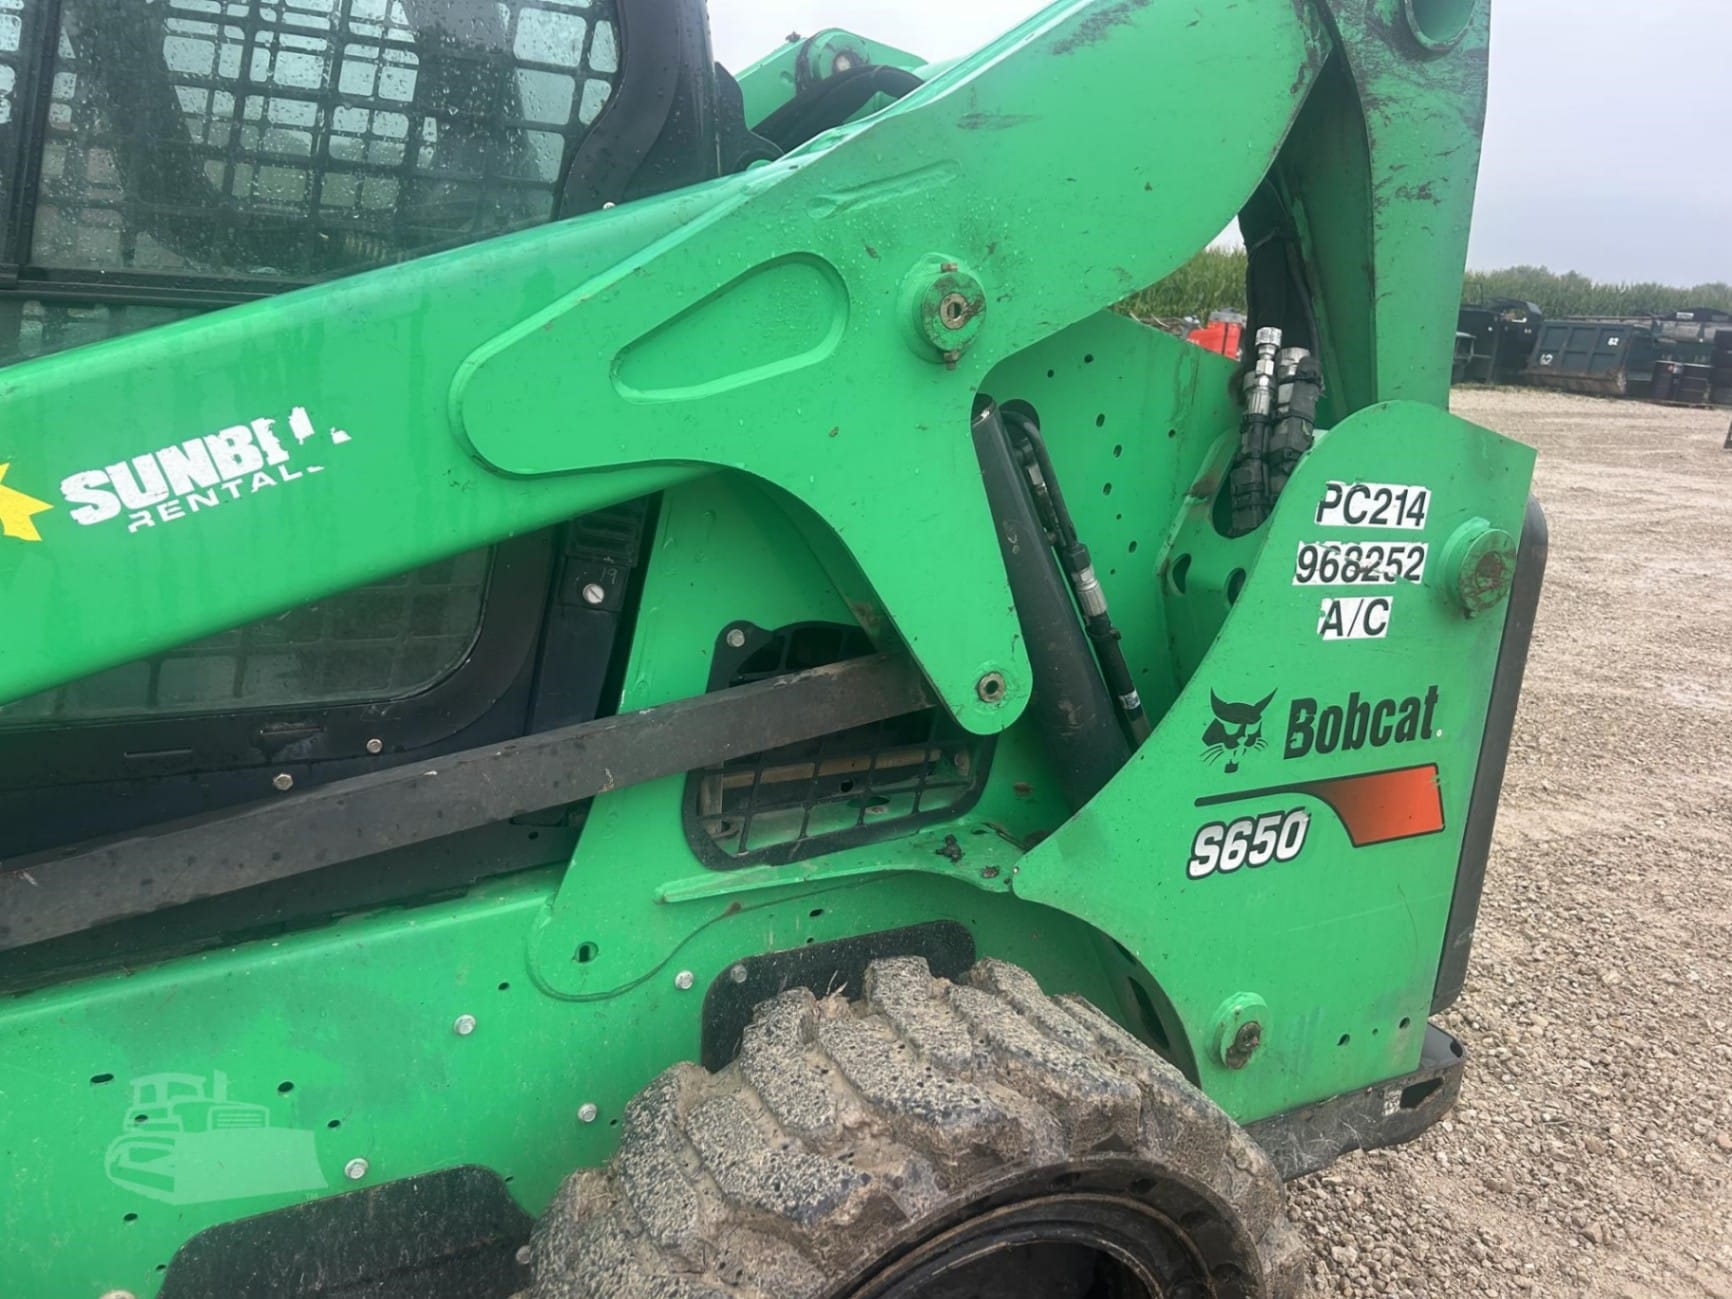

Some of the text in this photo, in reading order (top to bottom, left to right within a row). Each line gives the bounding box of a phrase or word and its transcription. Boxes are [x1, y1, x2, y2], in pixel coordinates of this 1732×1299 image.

[1316, 483, 1427, 527] PC214
[1296, 545, 1425, 583] 968252
[1319, 598, 1390, 637] A/C
[1284, 685, 1439, 760] Bobcat
[1187, 806, 1311, 880] S650
